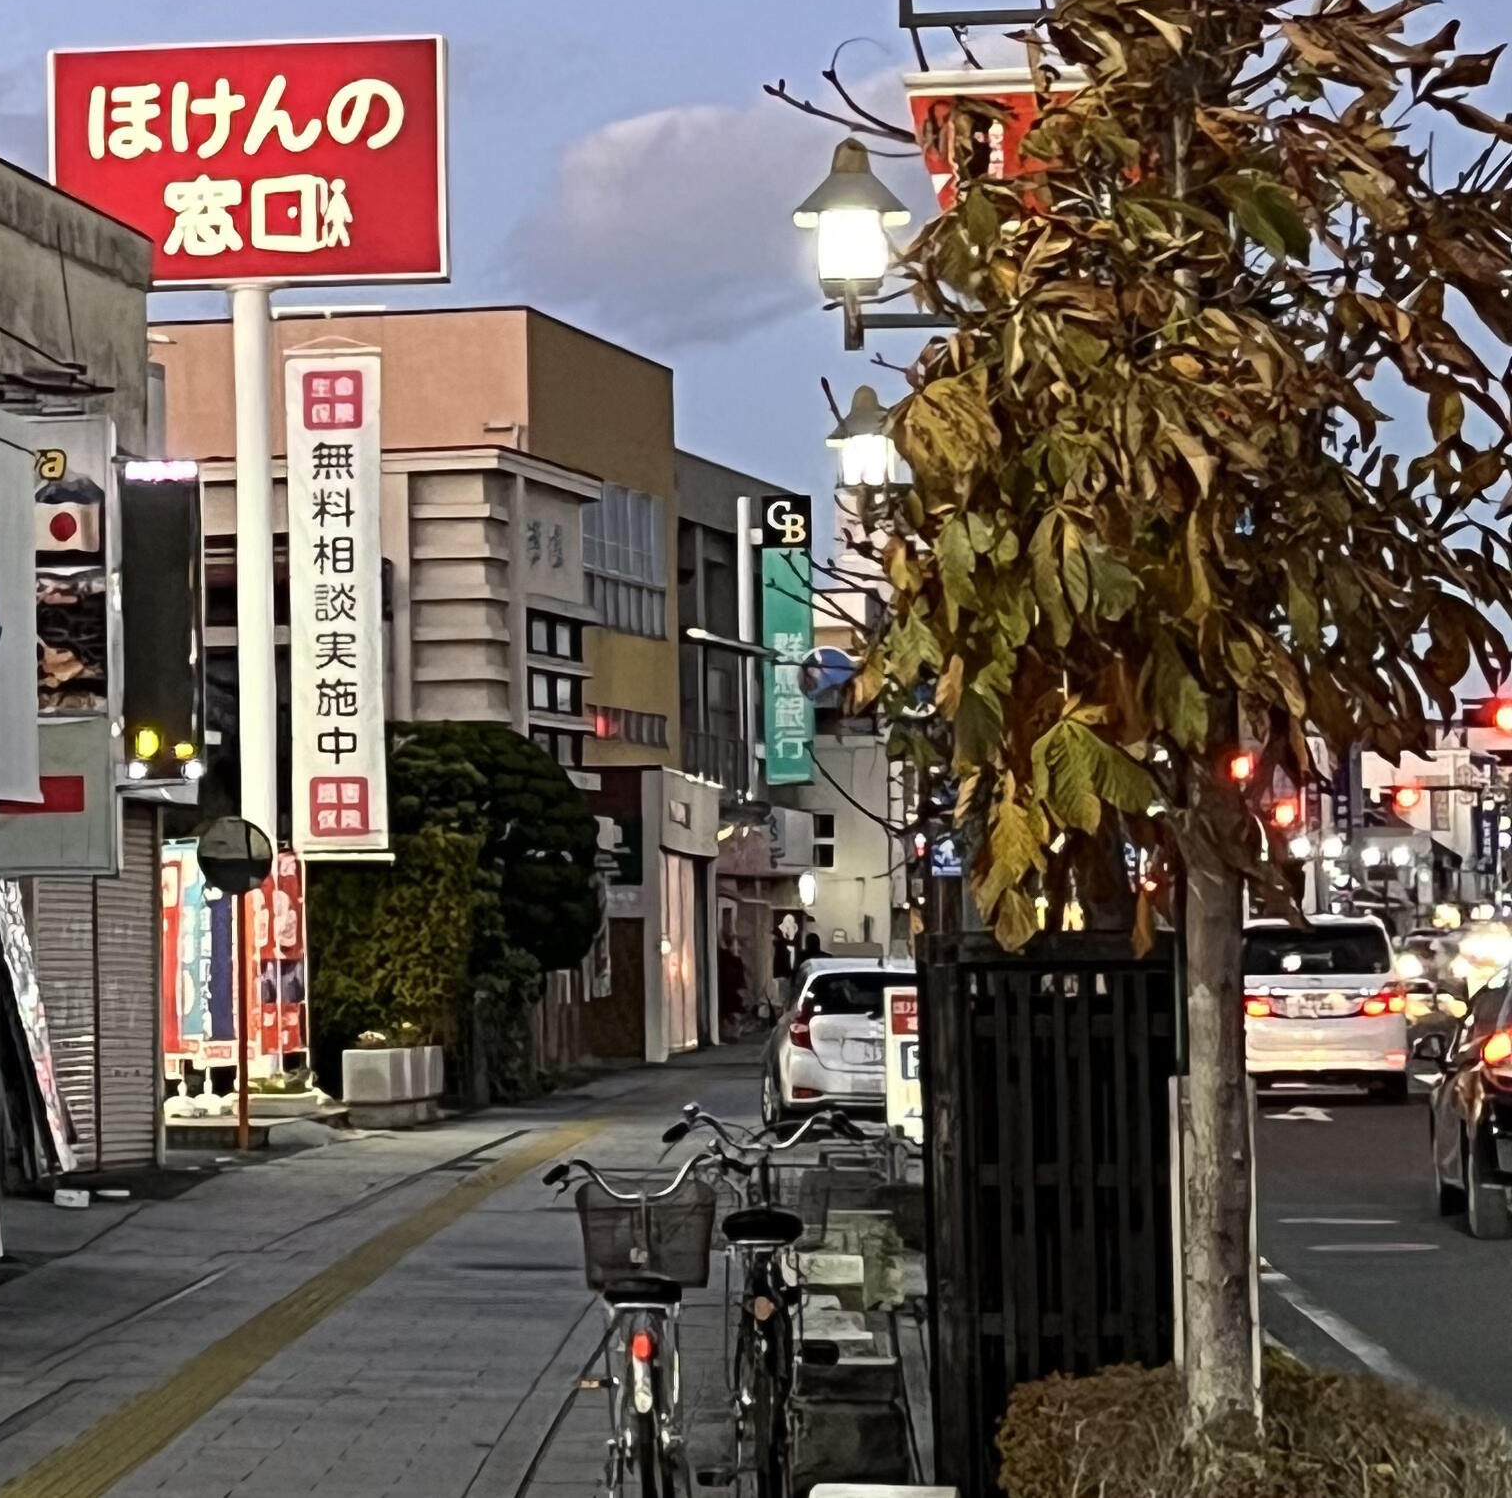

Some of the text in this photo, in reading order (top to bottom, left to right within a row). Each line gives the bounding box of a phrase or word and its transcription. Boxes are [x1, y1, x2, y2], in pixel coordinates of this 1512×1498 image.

[89, 74, 405, 159] ほけんの
[312, 442, 358, 764] 無料相談実施中
